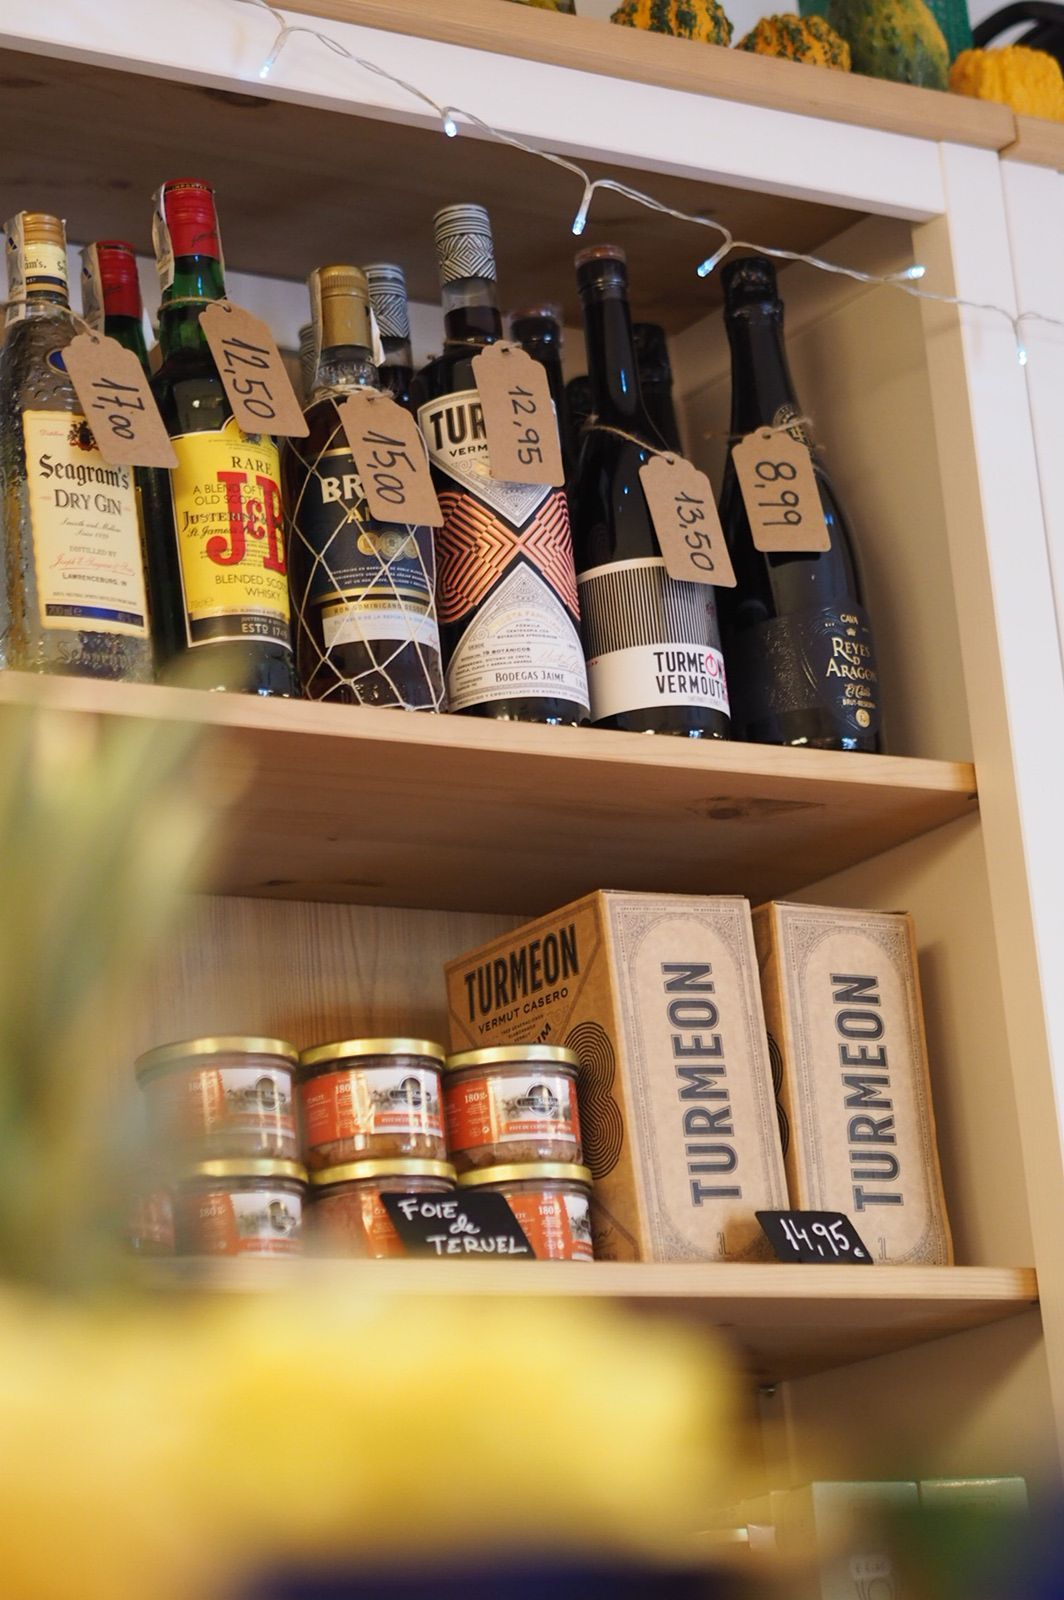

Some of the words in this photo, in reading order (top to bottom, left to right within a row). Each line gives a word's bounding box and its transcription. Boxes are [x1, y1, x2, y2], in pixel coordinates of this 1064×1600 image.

[222, 337, 275, 419] 12,50
[91, 377, 145, 440] 17,00
[429, 402, 487, 451] TUR
[508, 386, 543, 465] 12,95
[231, 456, 273, 476] RARE
[362, 430, 416, 504] 15,00
[449, 445, 488, 457] VERM
[39, 454, 130, 490] Seagram's
[321, 473, 365, 504] BR
[54, 489, 91, 510] DRY
[94, 493, 122, 517] GIN
[194, 495, 220, 506] OLD
[754, 461, 802, 526] 8,99
[206, 471, 286, 577] J&B
[674, 491, 714, 572] 13,50
[215, 574, 264, 585] BLENDED
[245, 587, 281, 600] WHISKY
[840, 614, 858, 625] CAVA
[831, 637, 871, 662] REYES
[495, 671, 539, 683] BODEGAS
[541, 671, 566, 683] JAIME
[464, 923, 580, 1023] TURMEON
[478, 1007, 520, 1035] VERMUT
[523, 987, 569, 1014] CASERO
[660, 961, 742, 1207] TURMEON
[829, 972, 904, 1213] TURMEON
[398, 1199, 459, 1221] FOIE
[426, 1235, 528, 1256] TERUEL
